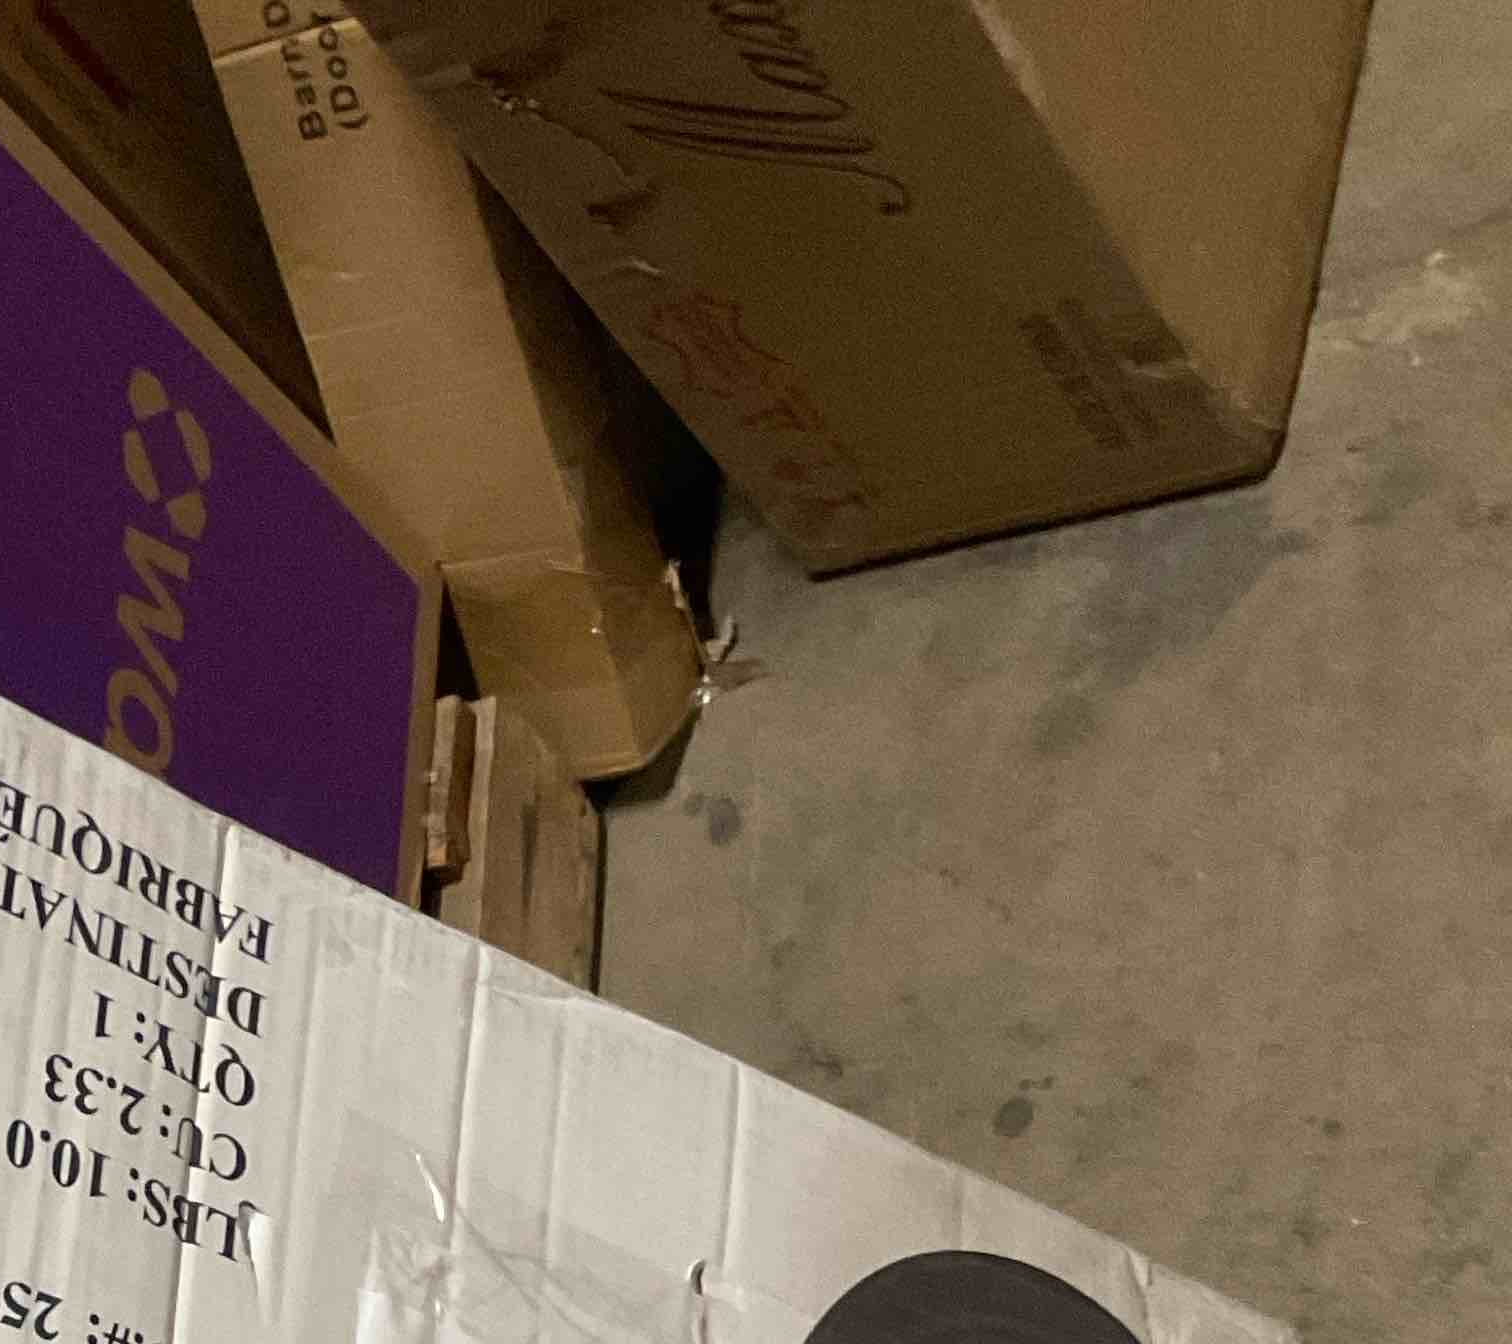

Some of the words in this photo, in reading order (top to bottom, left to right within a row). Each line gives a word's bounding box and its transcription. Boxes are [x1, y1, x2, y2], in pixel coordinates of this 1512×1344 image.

[92, 991, 114, 1038] 1
[43, 1053, 146, 1135] 2.33
[134, 1012, 256, 1108] QTY:
[5, 1119, 111, 1199] 10.0
[160, 1103, 247, 1182] CU:
[127, 1168, 238, 1262] LBS:
